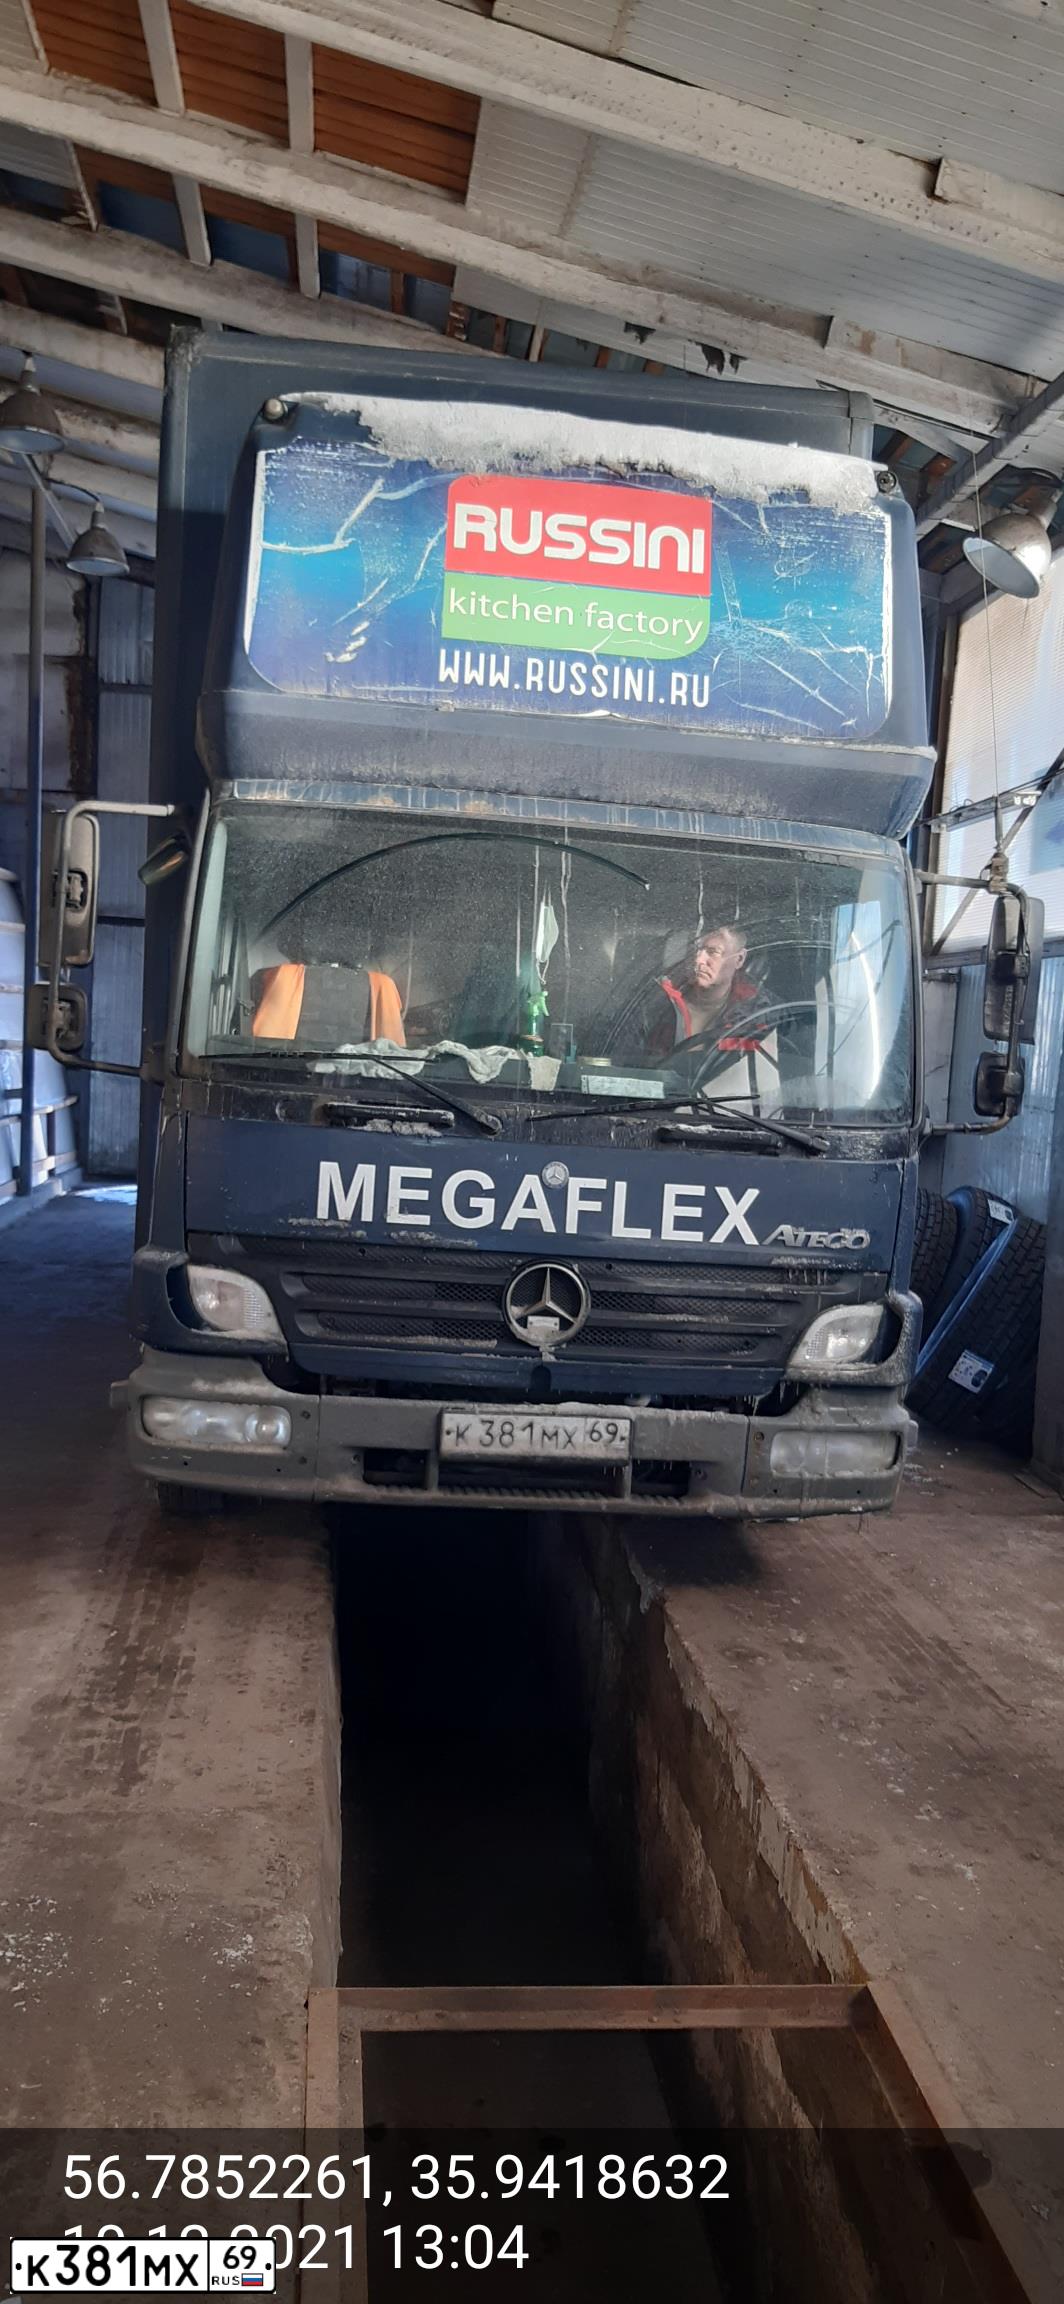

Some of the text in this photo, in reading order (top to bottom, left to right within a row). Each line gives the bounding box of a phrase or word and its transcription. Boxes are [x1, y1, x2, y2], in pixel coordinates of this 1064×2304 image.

[453, 503, 705, 575] RUSSINI
[447, 587, 704, 645] kitchen factory
[438, 649, 711, 709] WWW.RUSSINI.RU
[315, 1161, 761, 1246] MEGAFLEX
[589, 1421, 619, 1444] 69
